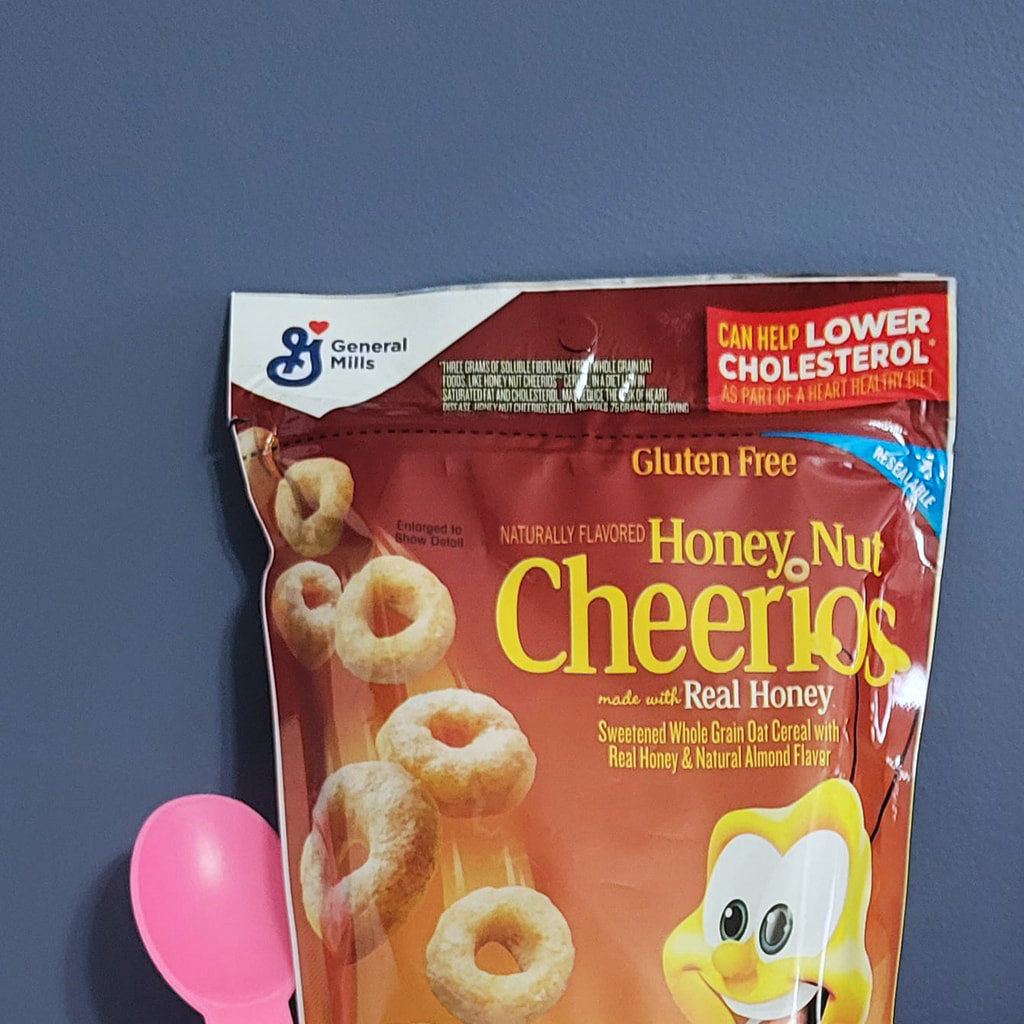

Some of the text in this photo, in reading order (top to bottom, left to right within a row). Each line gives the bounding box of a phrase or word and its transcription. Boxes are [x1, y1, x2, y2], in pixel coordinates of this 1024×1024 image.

[718, 307, 930, 350] CAN HELP LOWER
[331, 337, 407, 353] General
[331, 356, 375, 370] Mills
[722, 369, 934, 405] AS PART OF A HEART HEALTHY DIET
[631, 446, 798, 477] Gluten Free
[872, 446, 937, 510] RESEALABLE
[395, 533, 464, 548] Show Detail
[397, 520, 462, 535] Enlarged to
[501, 523, 646, 545] NATURALLY FLAVORED
[648, 517, 884, 580] Honey Nut
[495, 553, 911, 688] Cheerios
[598, 687, 681, 706] made with
[683, 679, 834, 715] Real Honey
[598, 719, 840, 744] Sweetened Whole Grain Oat Cereal with
[608, 745, 832, 774] Real Honey & Natural Almond Flavor
